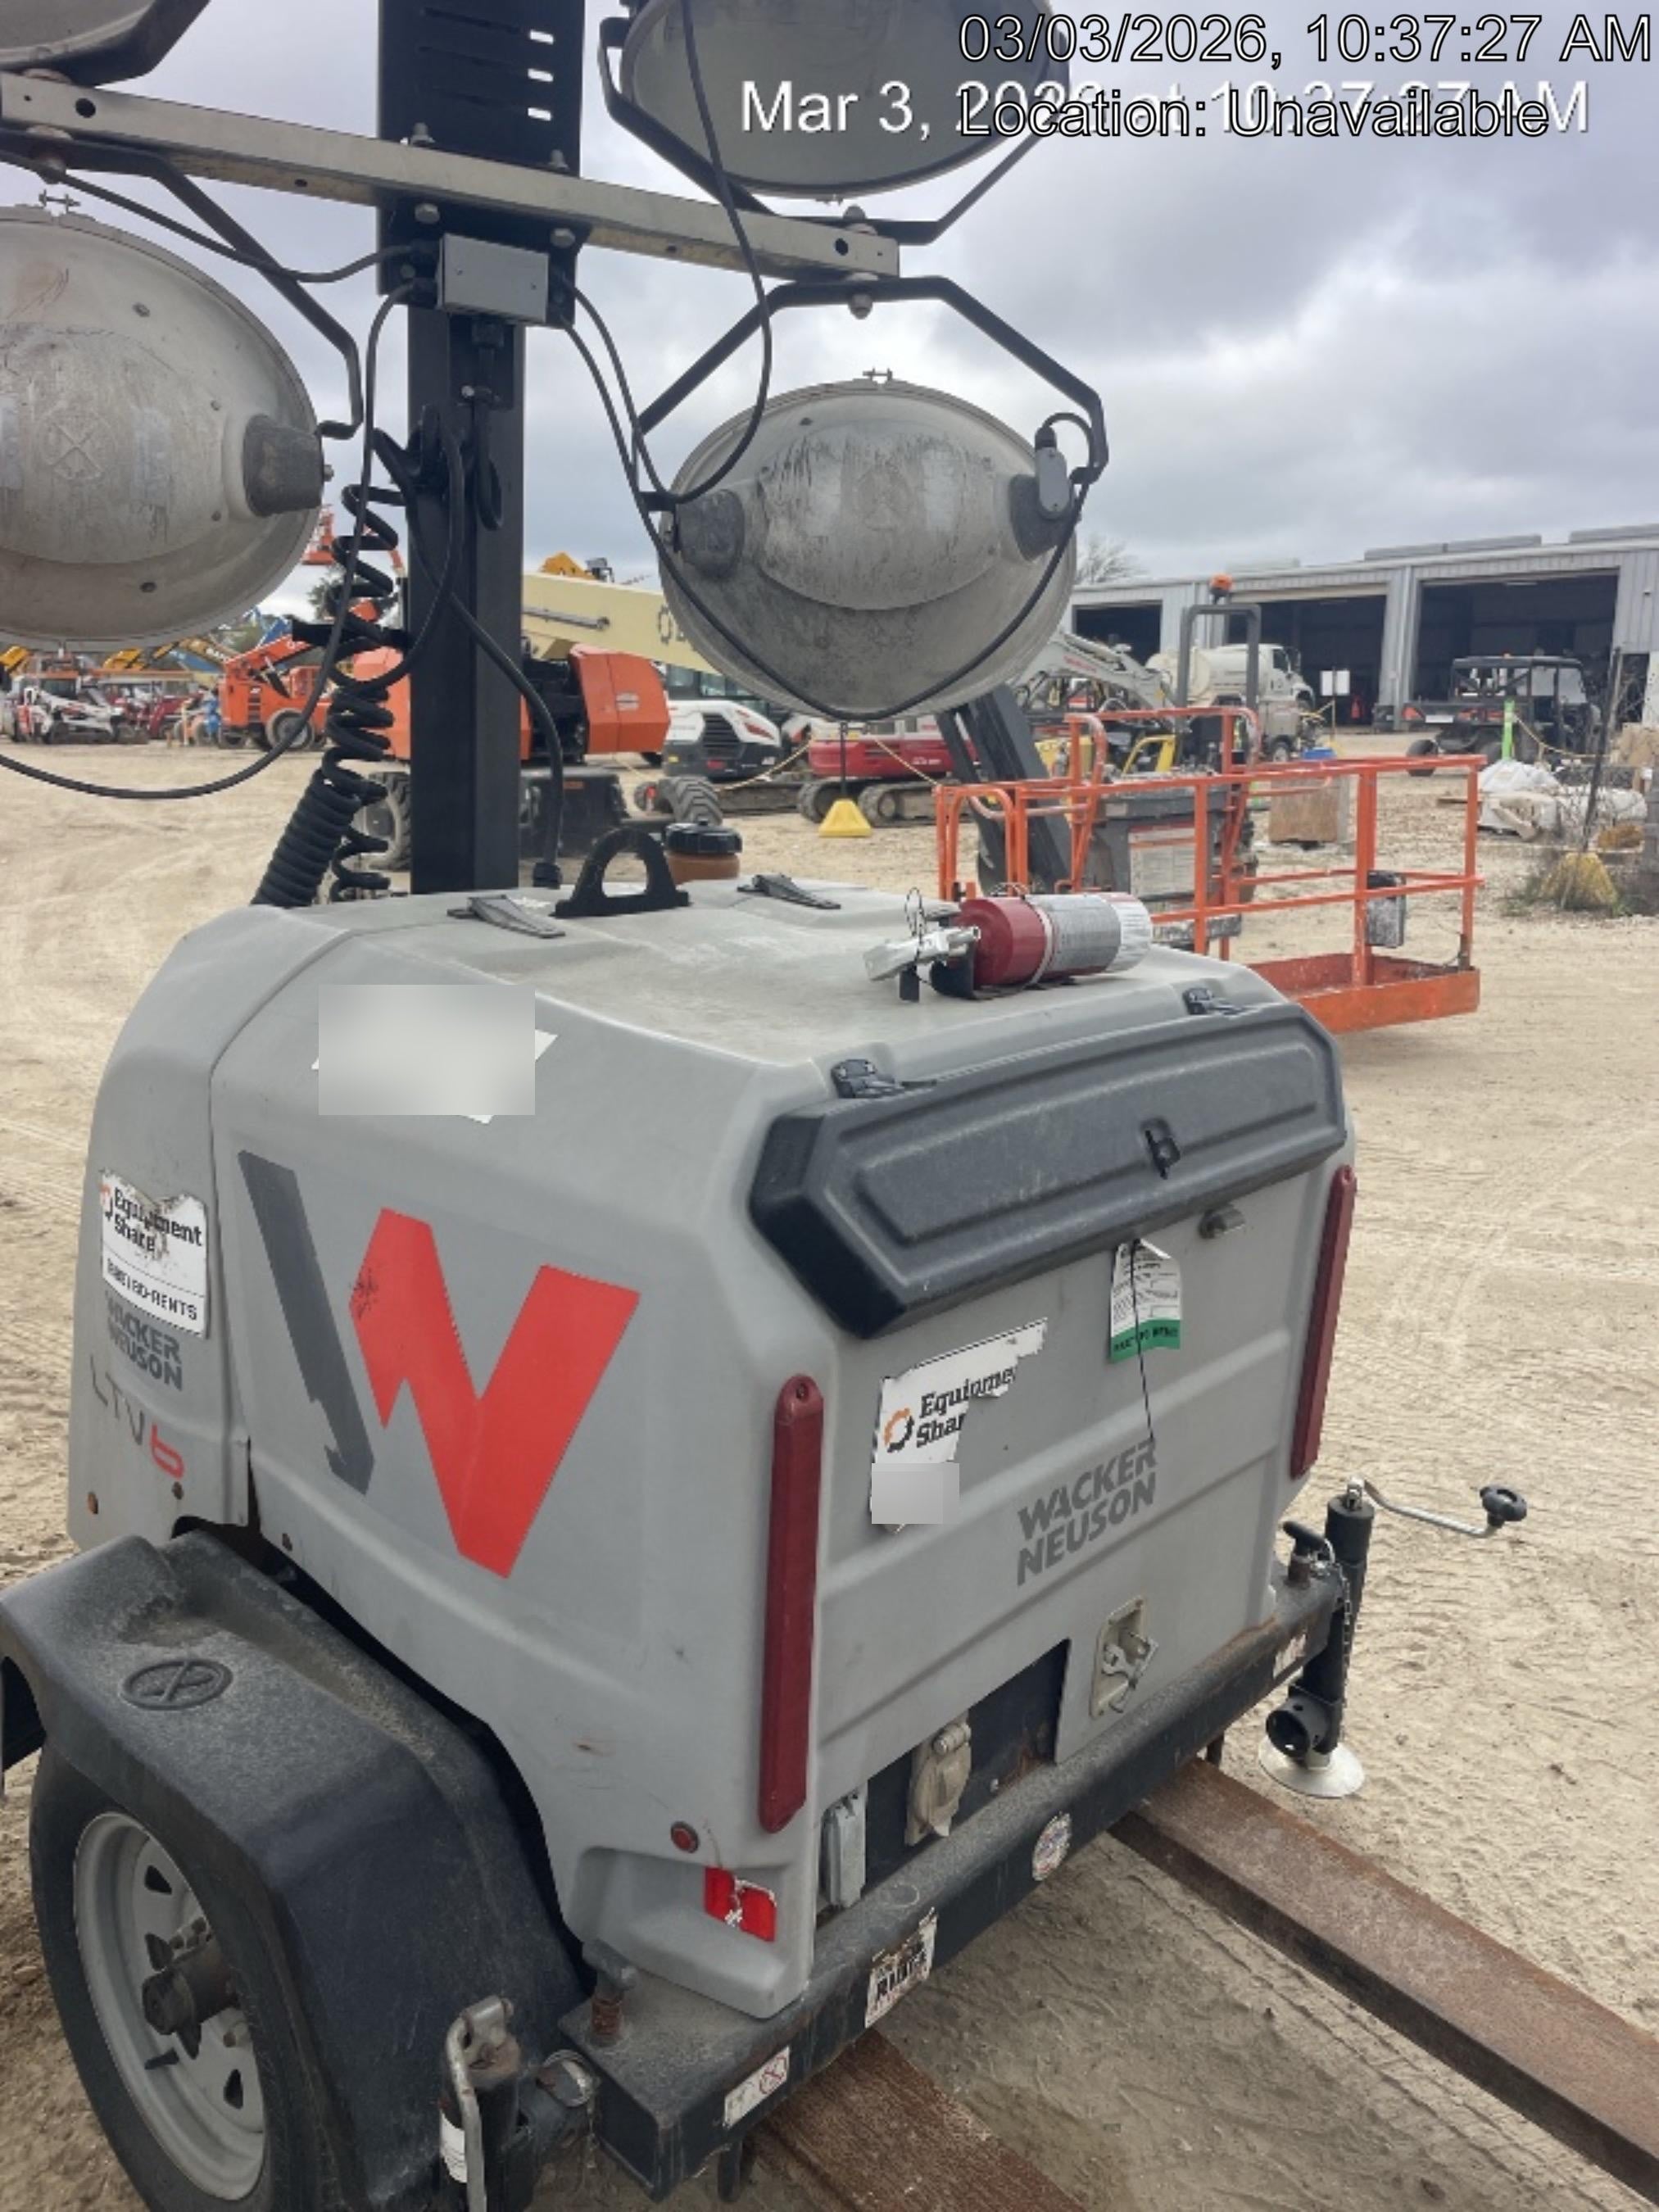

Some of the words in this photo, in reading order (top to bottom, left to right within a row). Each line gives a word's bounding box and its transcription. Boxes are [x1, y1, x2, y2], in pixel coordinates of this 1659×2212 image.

[919, 1366, 1017, 1418] Equipme
[1017, 1471, 1156, 1587] NEUSON
[1018, 1436, 1158, 1541] WACKER
